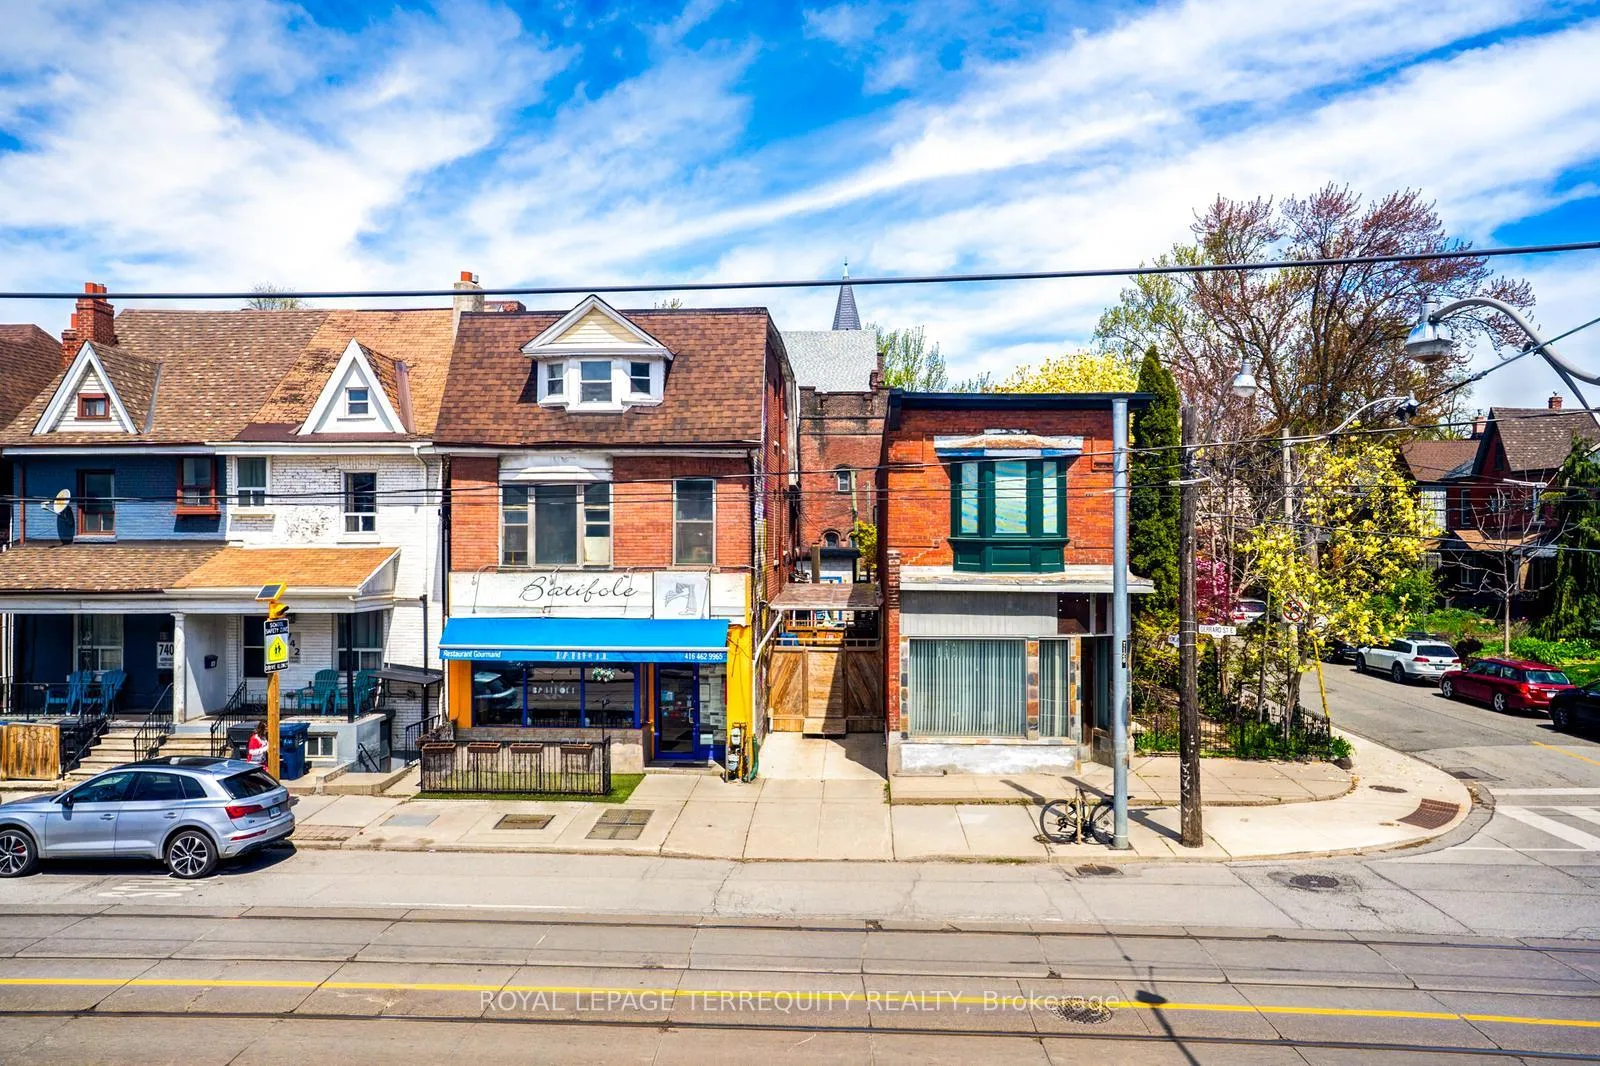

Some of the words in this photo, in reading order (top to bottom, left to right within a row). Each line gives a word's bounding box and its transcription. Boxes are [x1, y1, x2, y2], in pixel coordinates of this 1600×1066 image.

[519, 576, 638, 602] Batifole
[159, 643, 174, 656] 740
[443, 650, 472, 658] Restaurant
[473, 650, 501, 658] Gourmand
[685, 652, 695, 660] 416
[696, 652, 707, 660] 462
